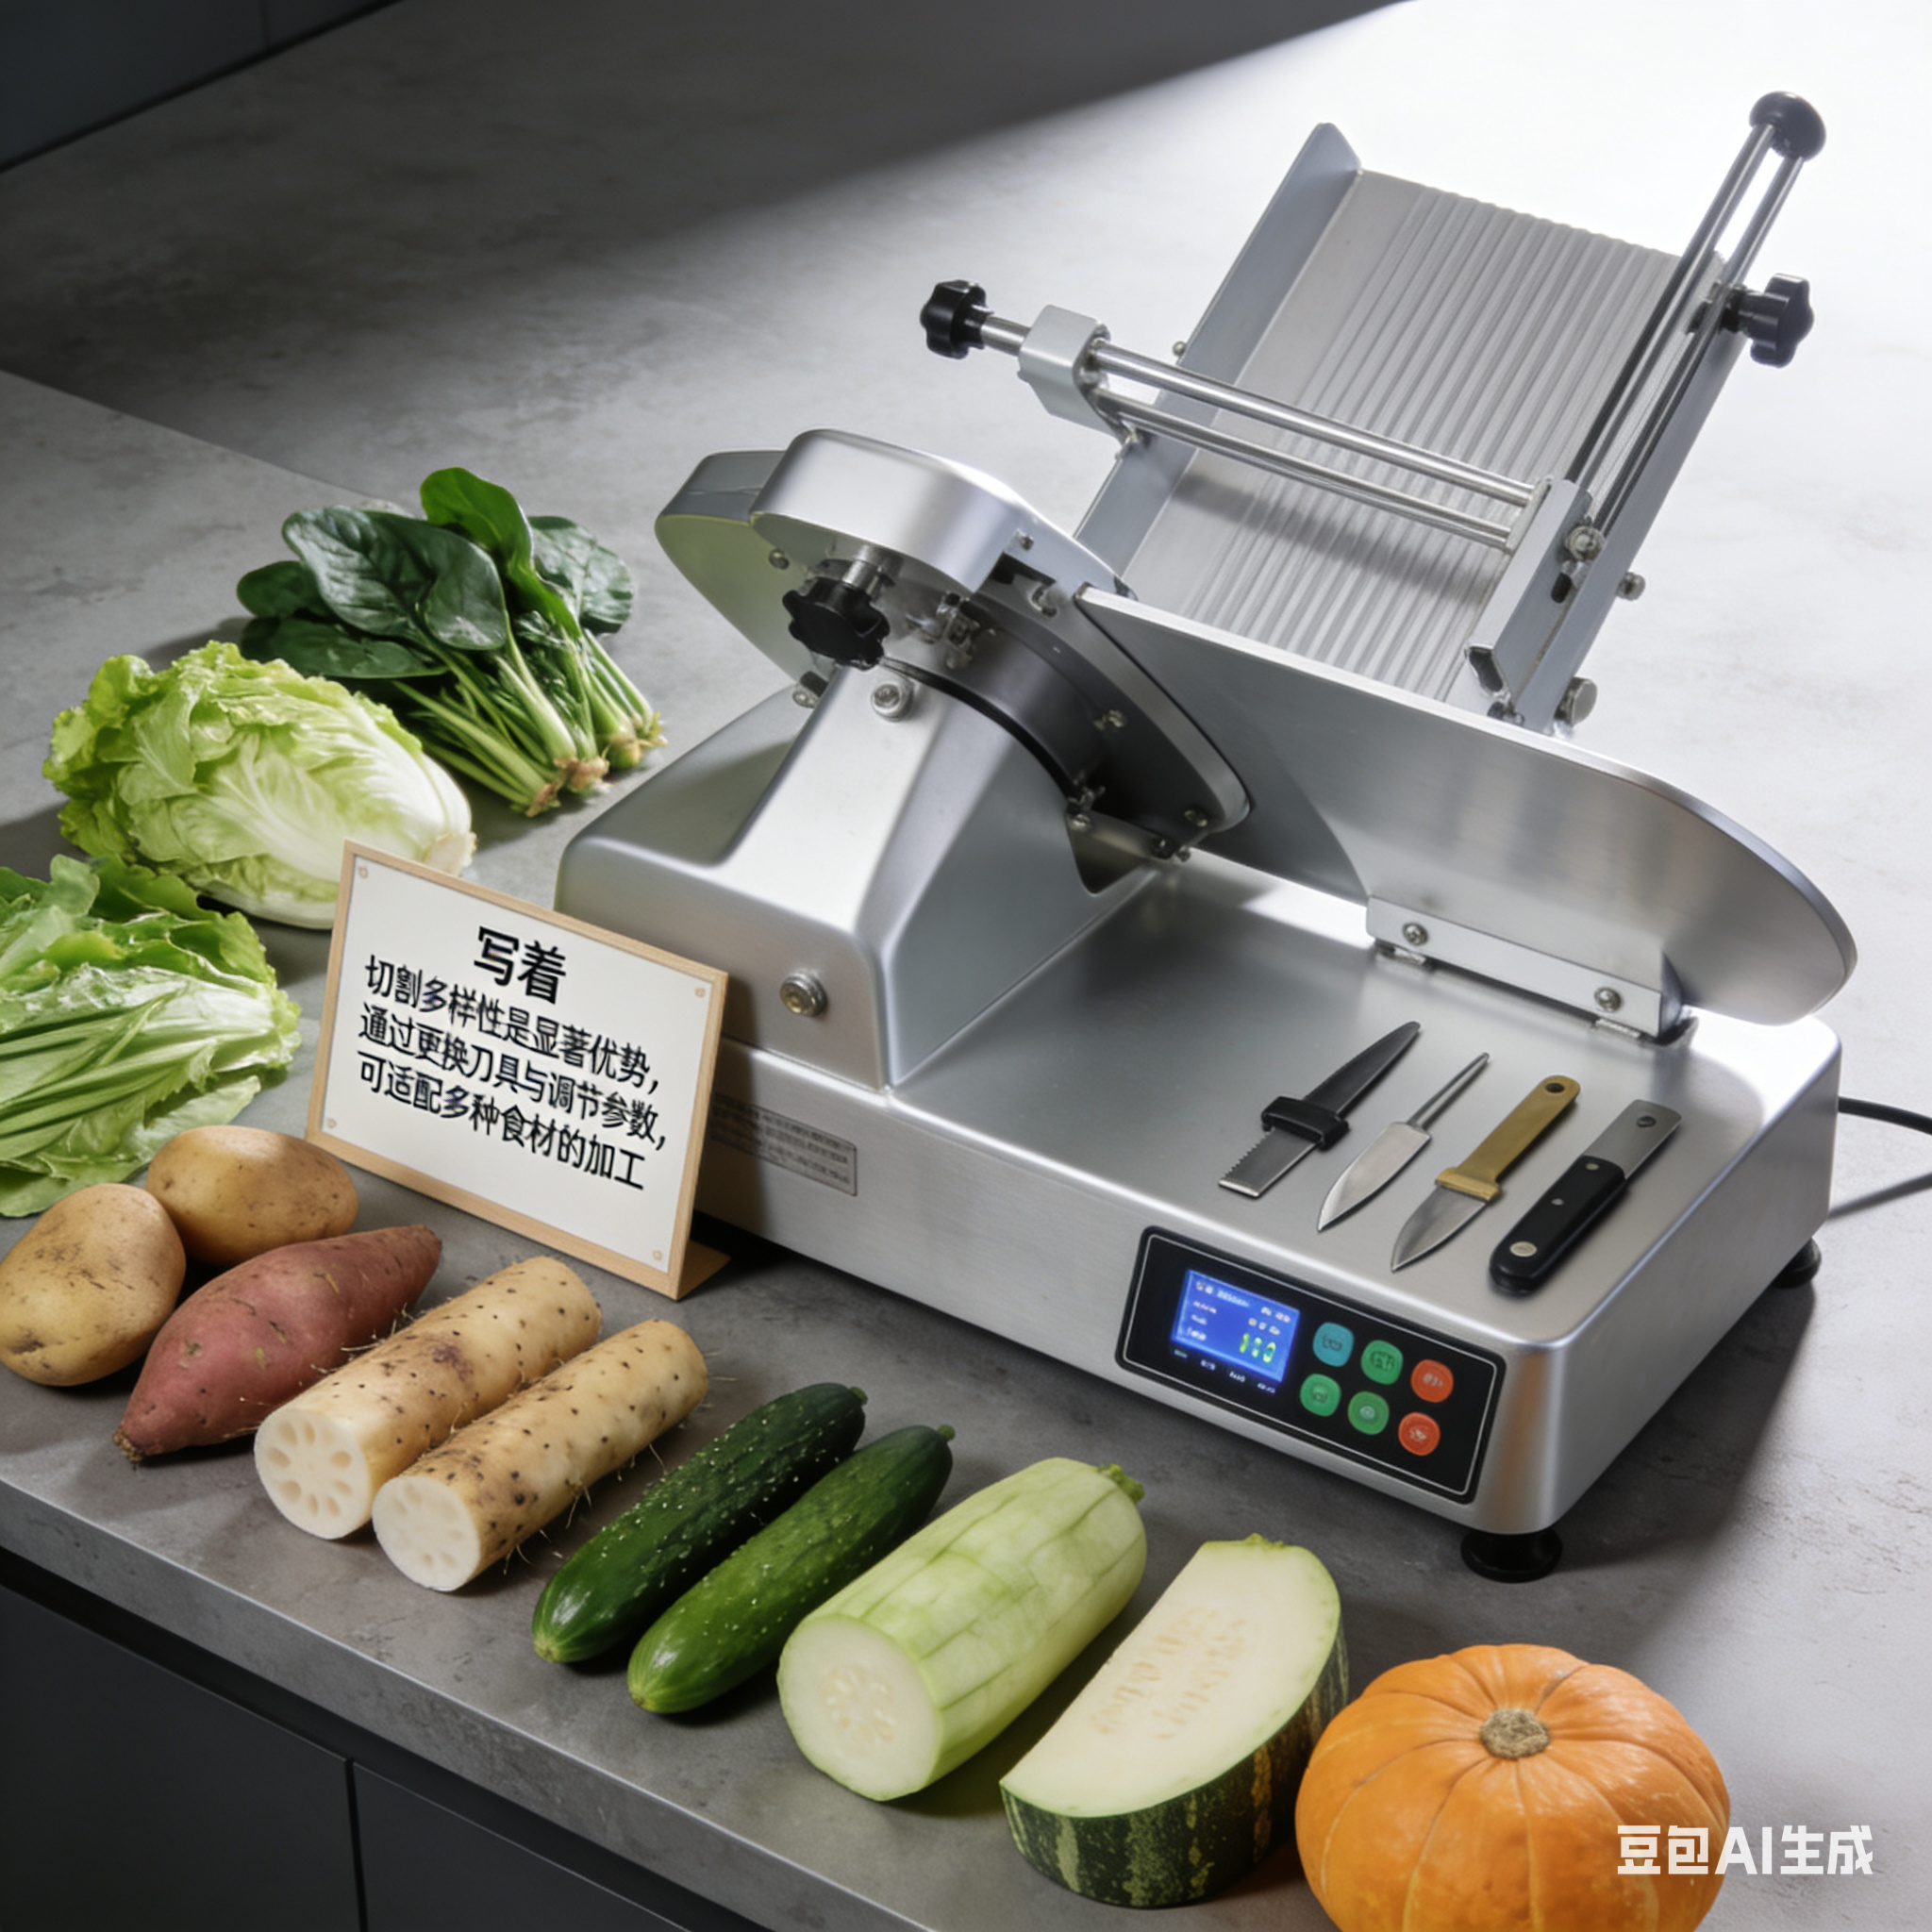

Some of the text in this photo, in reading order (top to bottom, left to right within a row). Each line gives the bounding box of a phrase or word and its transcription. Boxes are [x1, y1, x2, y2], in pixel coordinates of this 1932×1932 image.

[365, 955, 660, 1094] 切割多样性是显著优势，
[474, 925, 567, 1004] 写着
[358, 1003, 666, 1152] 通过更换刀具与调节参数，
[358, 1050, 645, 1191] 可适配多种食材的加工
